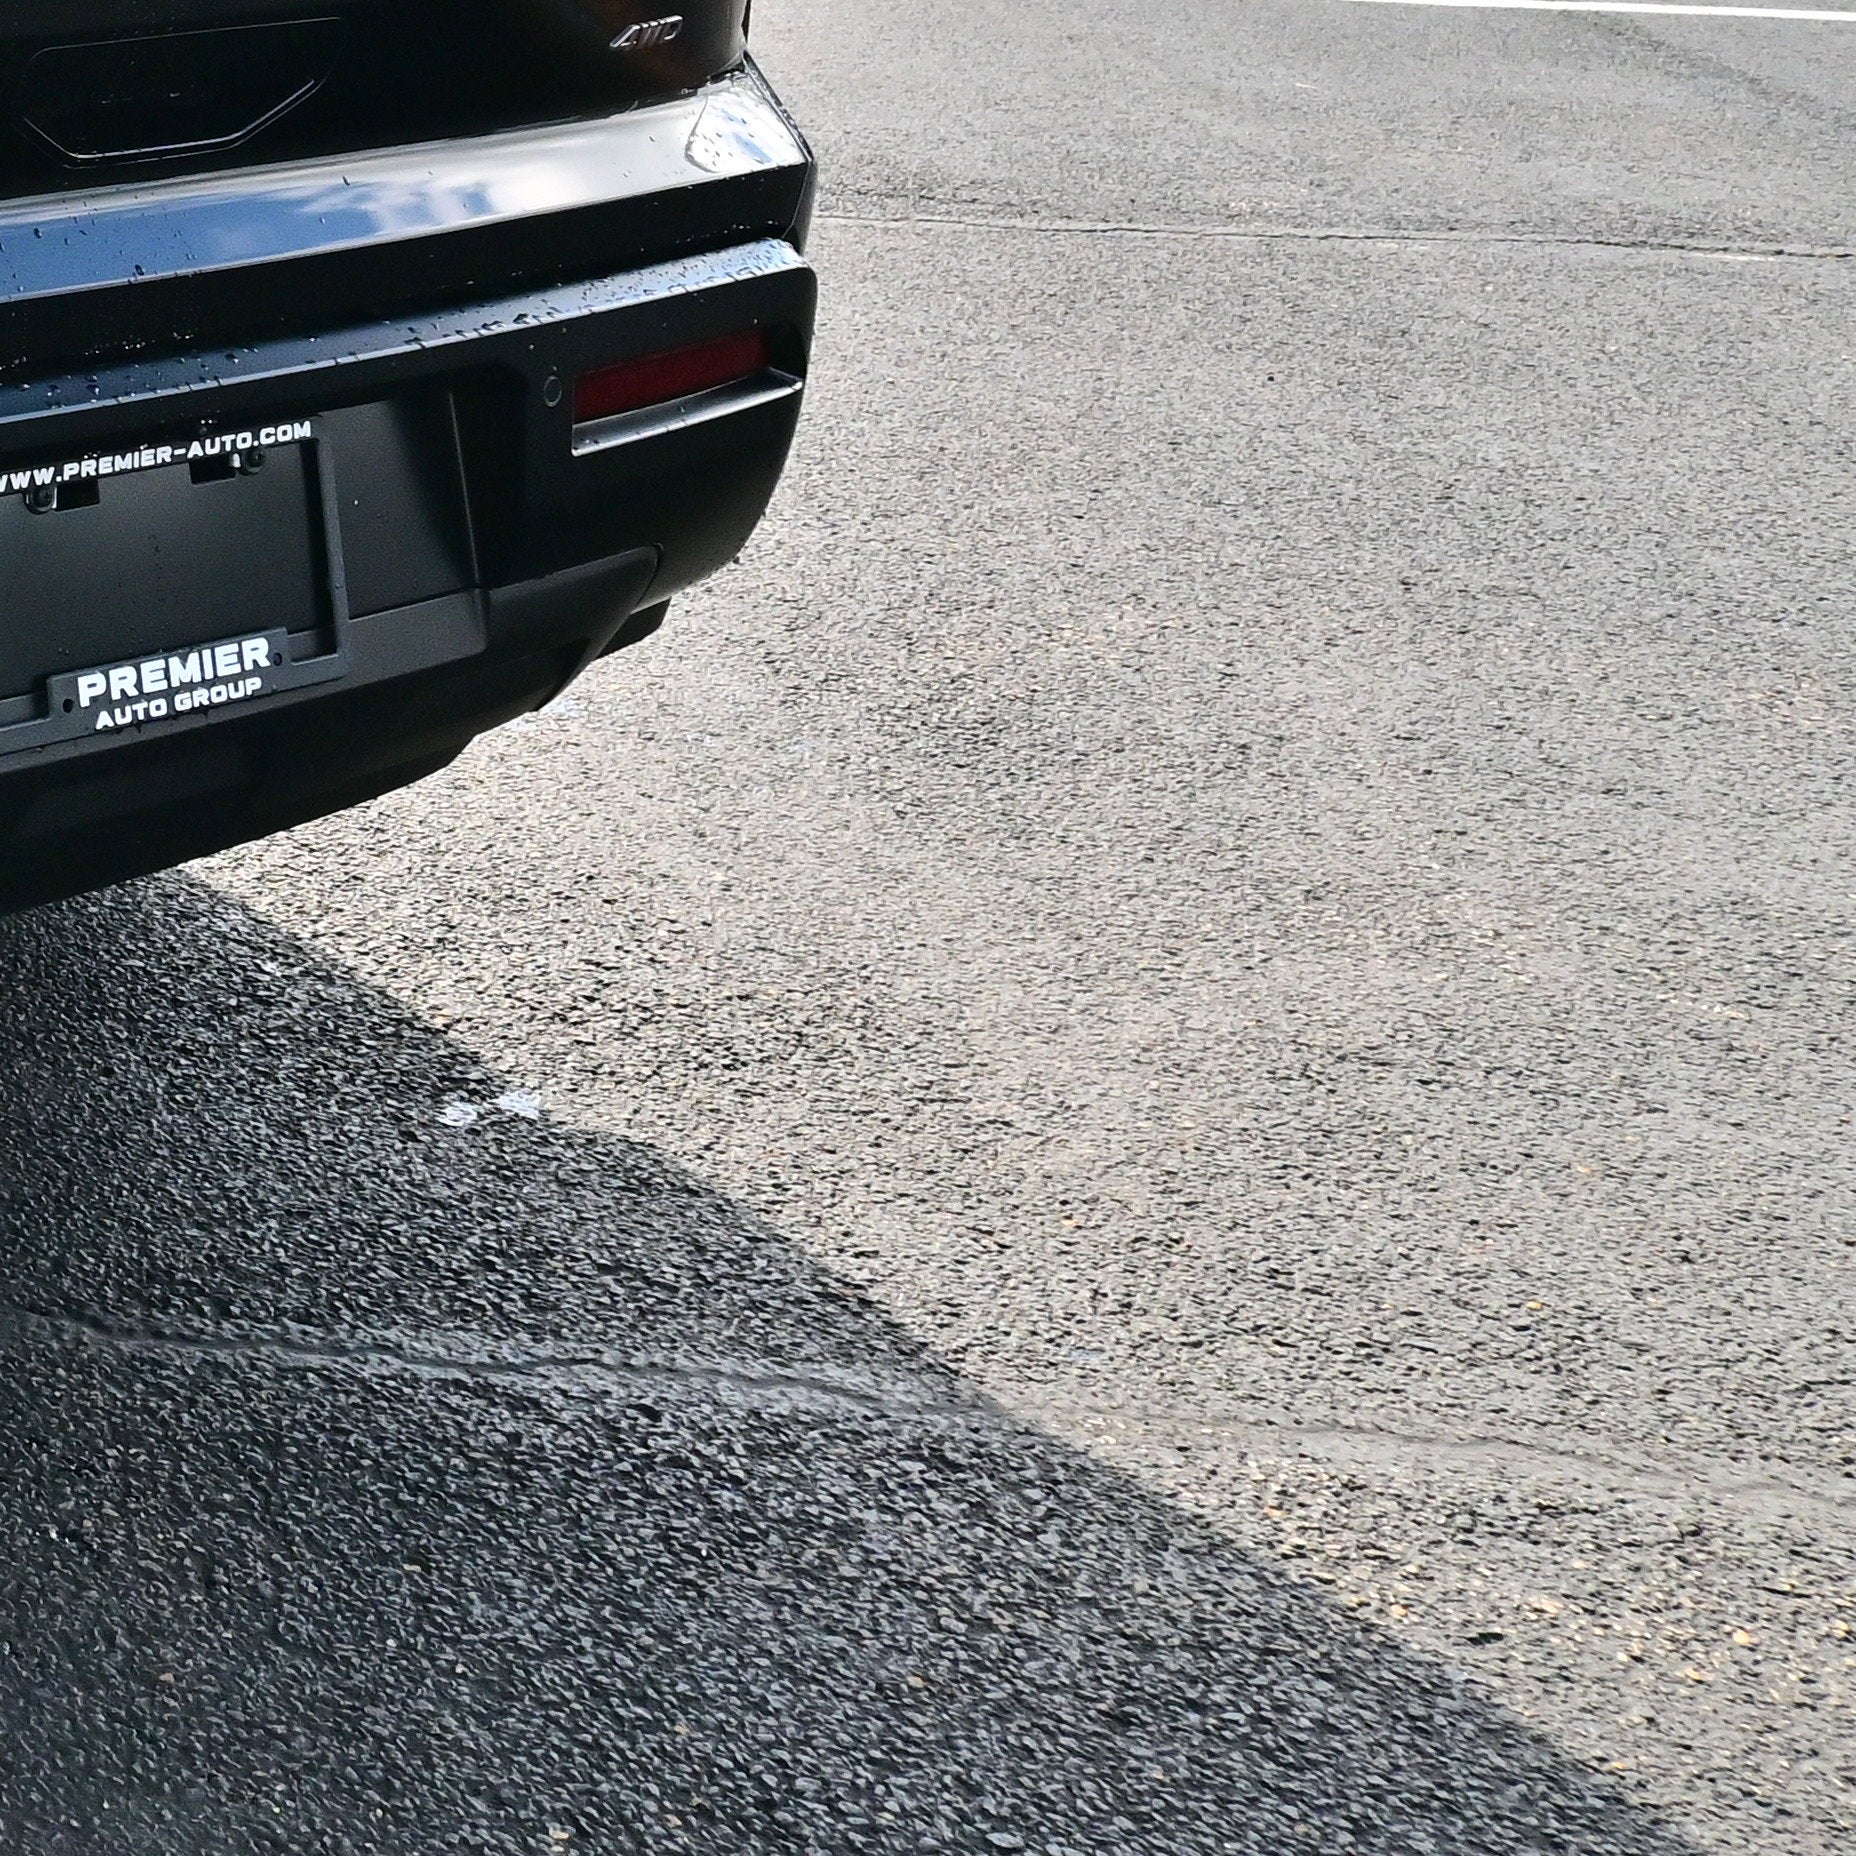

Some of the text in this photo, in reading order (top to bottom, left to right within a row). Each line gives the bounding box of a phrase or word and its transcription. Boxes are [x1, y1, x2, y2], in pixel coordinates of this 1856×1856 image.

[77, 637, 271, 708] PREMIER
[95, 676, 263, 730] AUTO GROUP
